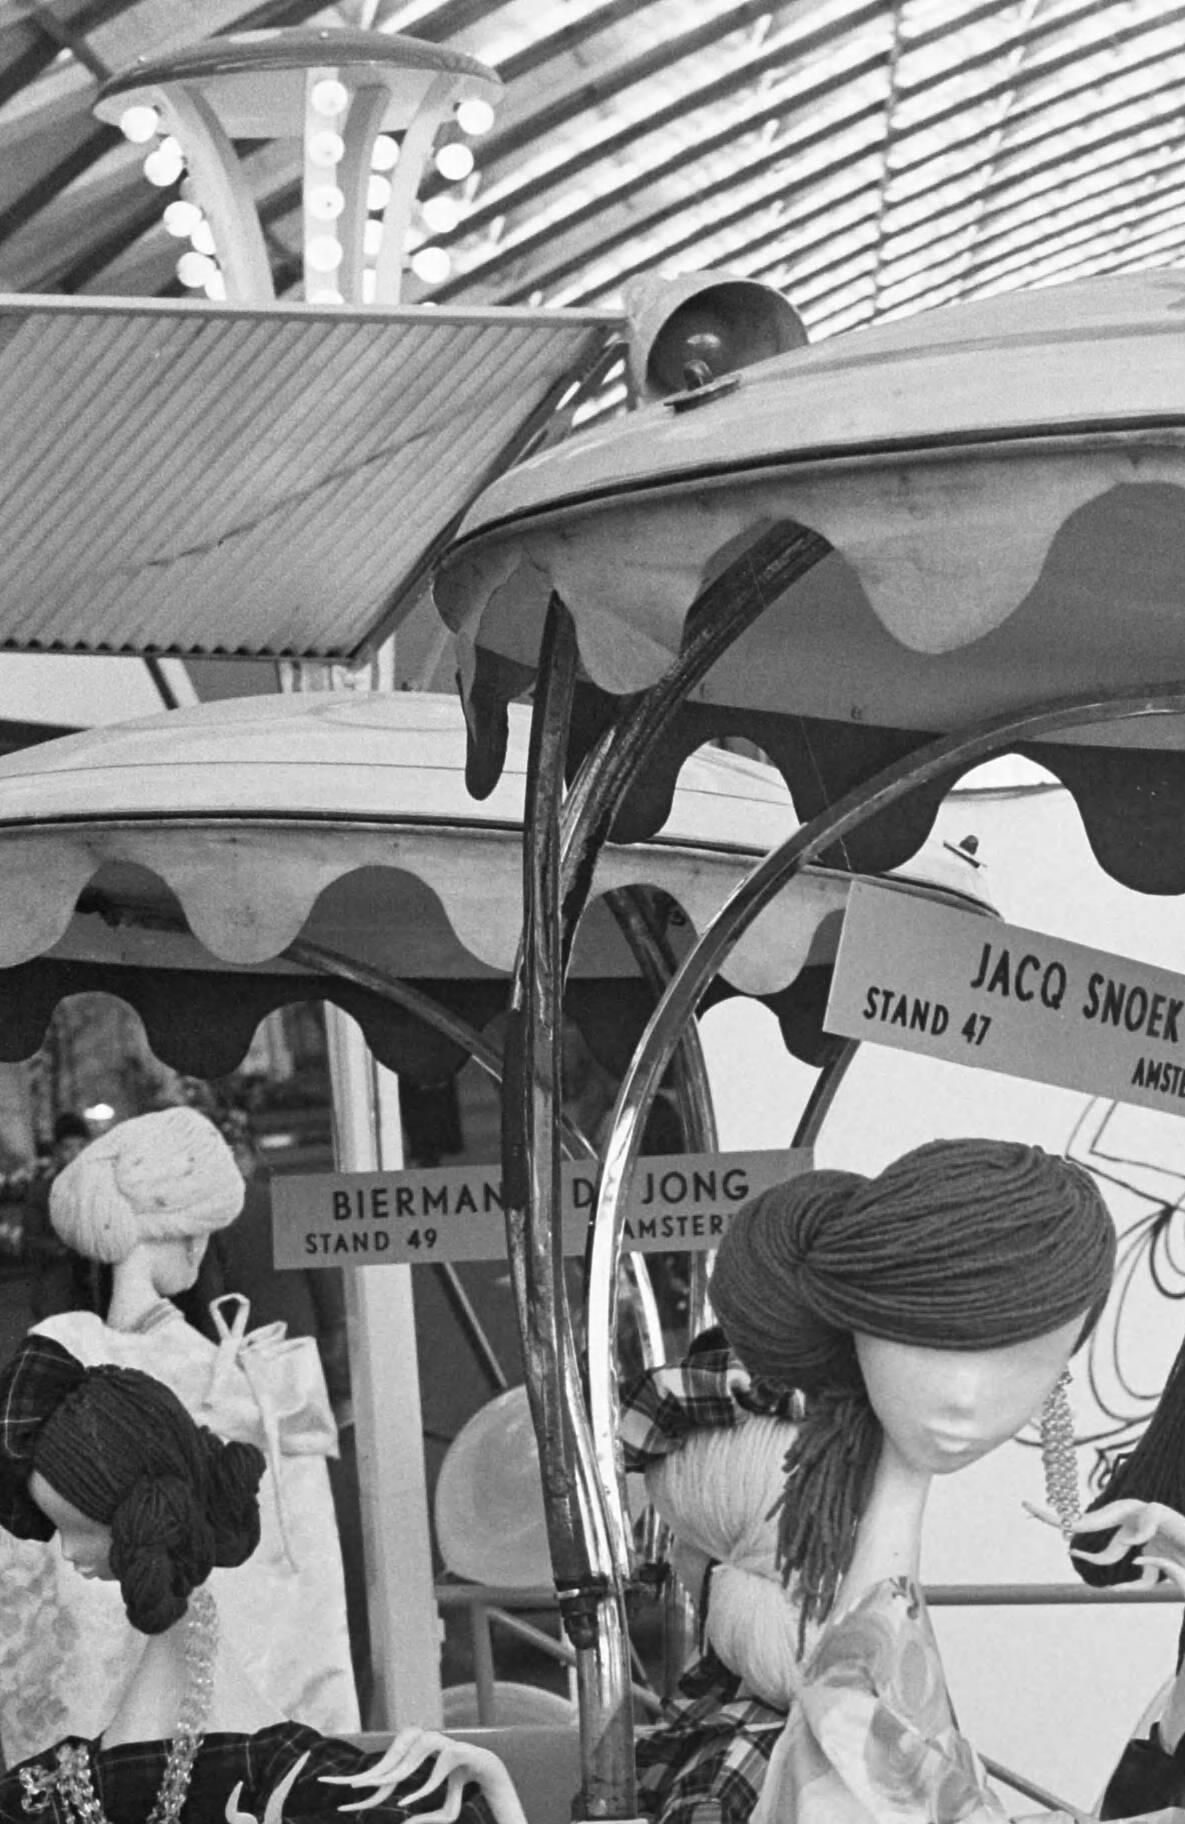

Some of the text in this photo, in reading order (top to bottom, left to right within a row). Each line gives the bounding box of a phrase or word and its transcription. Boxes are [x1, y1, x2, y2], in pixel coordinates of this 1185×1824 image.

[970, 942, 1185, 1044] JACQ SNOEK
[862, 986, 992, 1046] STAND 47
[641, 1168, 749, 1205] JONG
[305, 1227, 438, 1254] STAND 49
[622, 1213, 734, 1239] AMSTER
